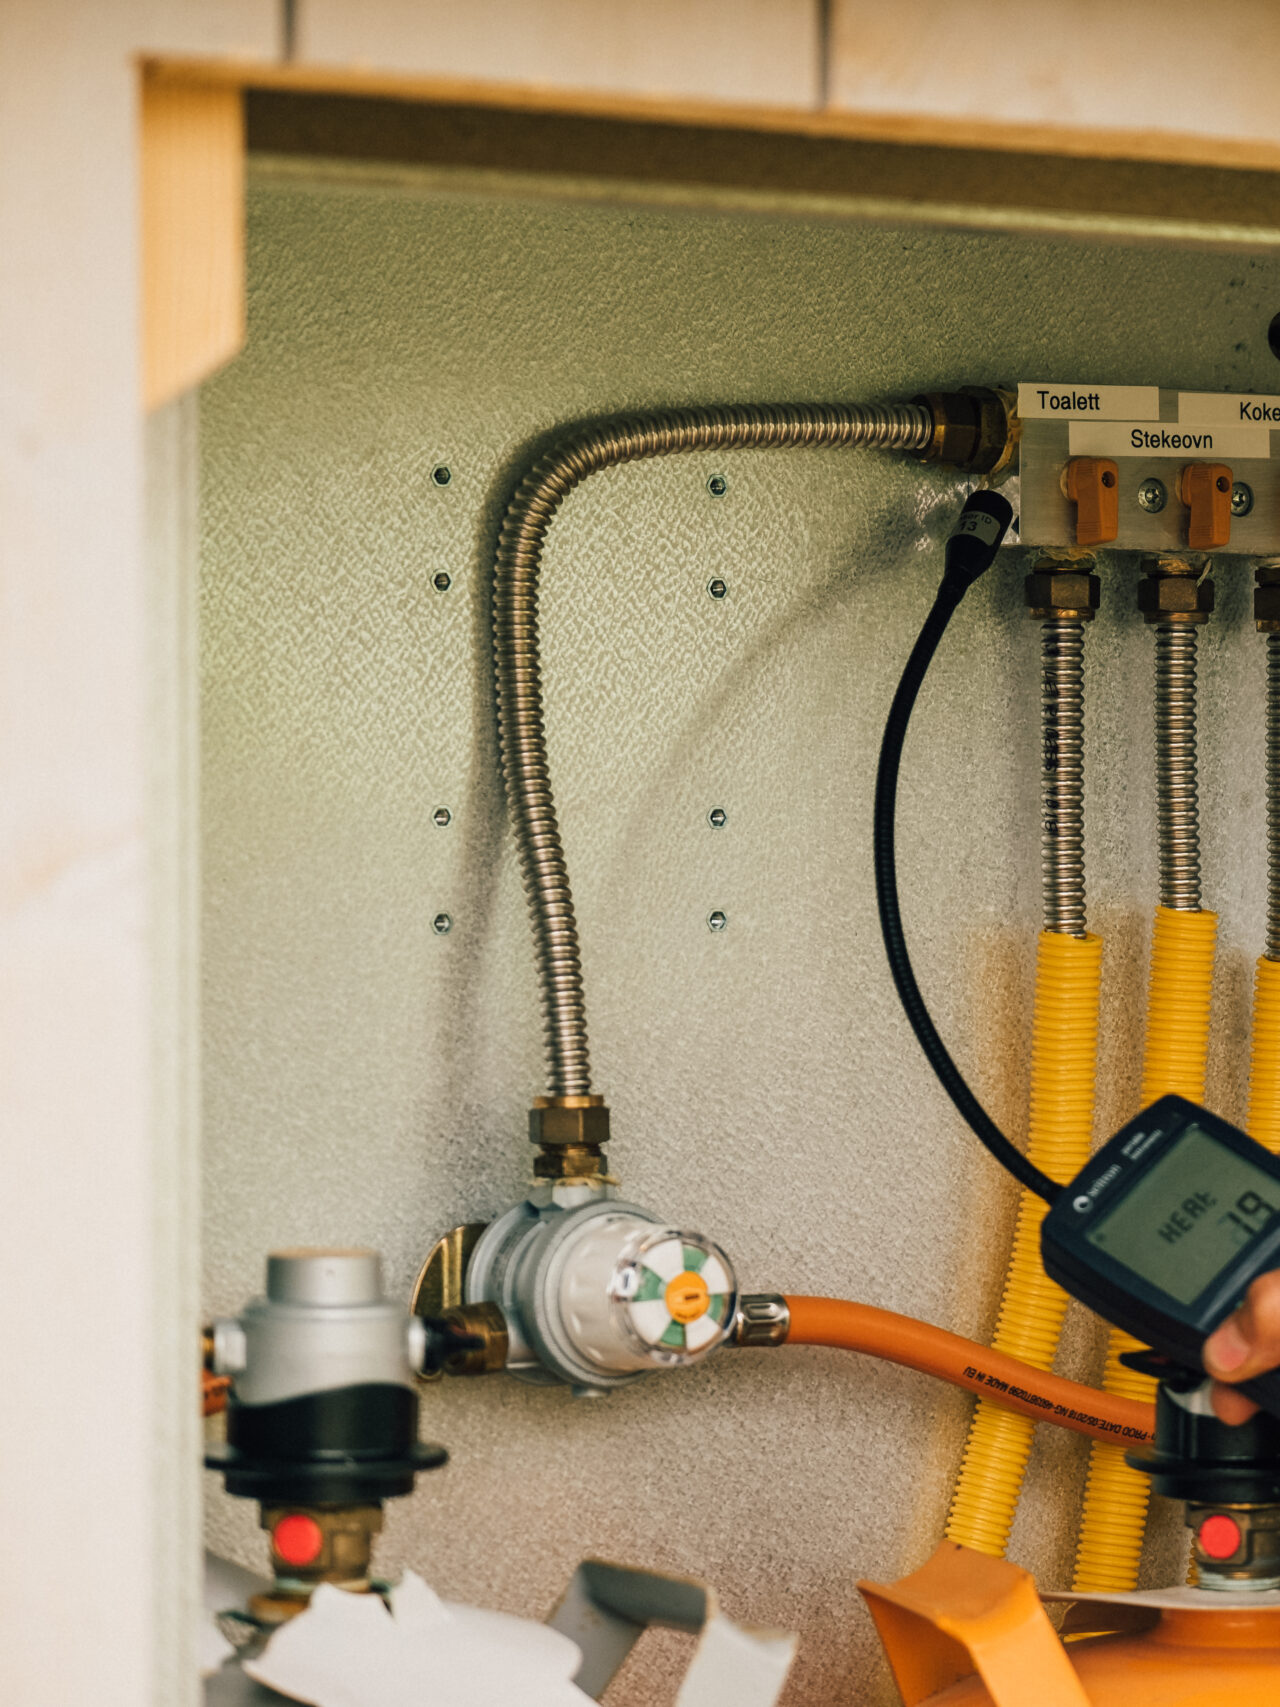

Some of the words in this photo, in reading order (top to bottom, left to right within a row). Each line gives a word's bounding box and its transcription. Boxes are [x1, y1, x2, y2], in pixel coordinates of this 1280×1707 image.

[1036, 390, 1101, 411] Toalett
[1130, 428, 1214, 449] Stekeovn
[962, 1366, 977, 1379] EU
[975, 1371, 986, 1383] IN
[984, 1375, 1009, 1393] MADE
[1121, 1427, 1148, 1441] PROD
